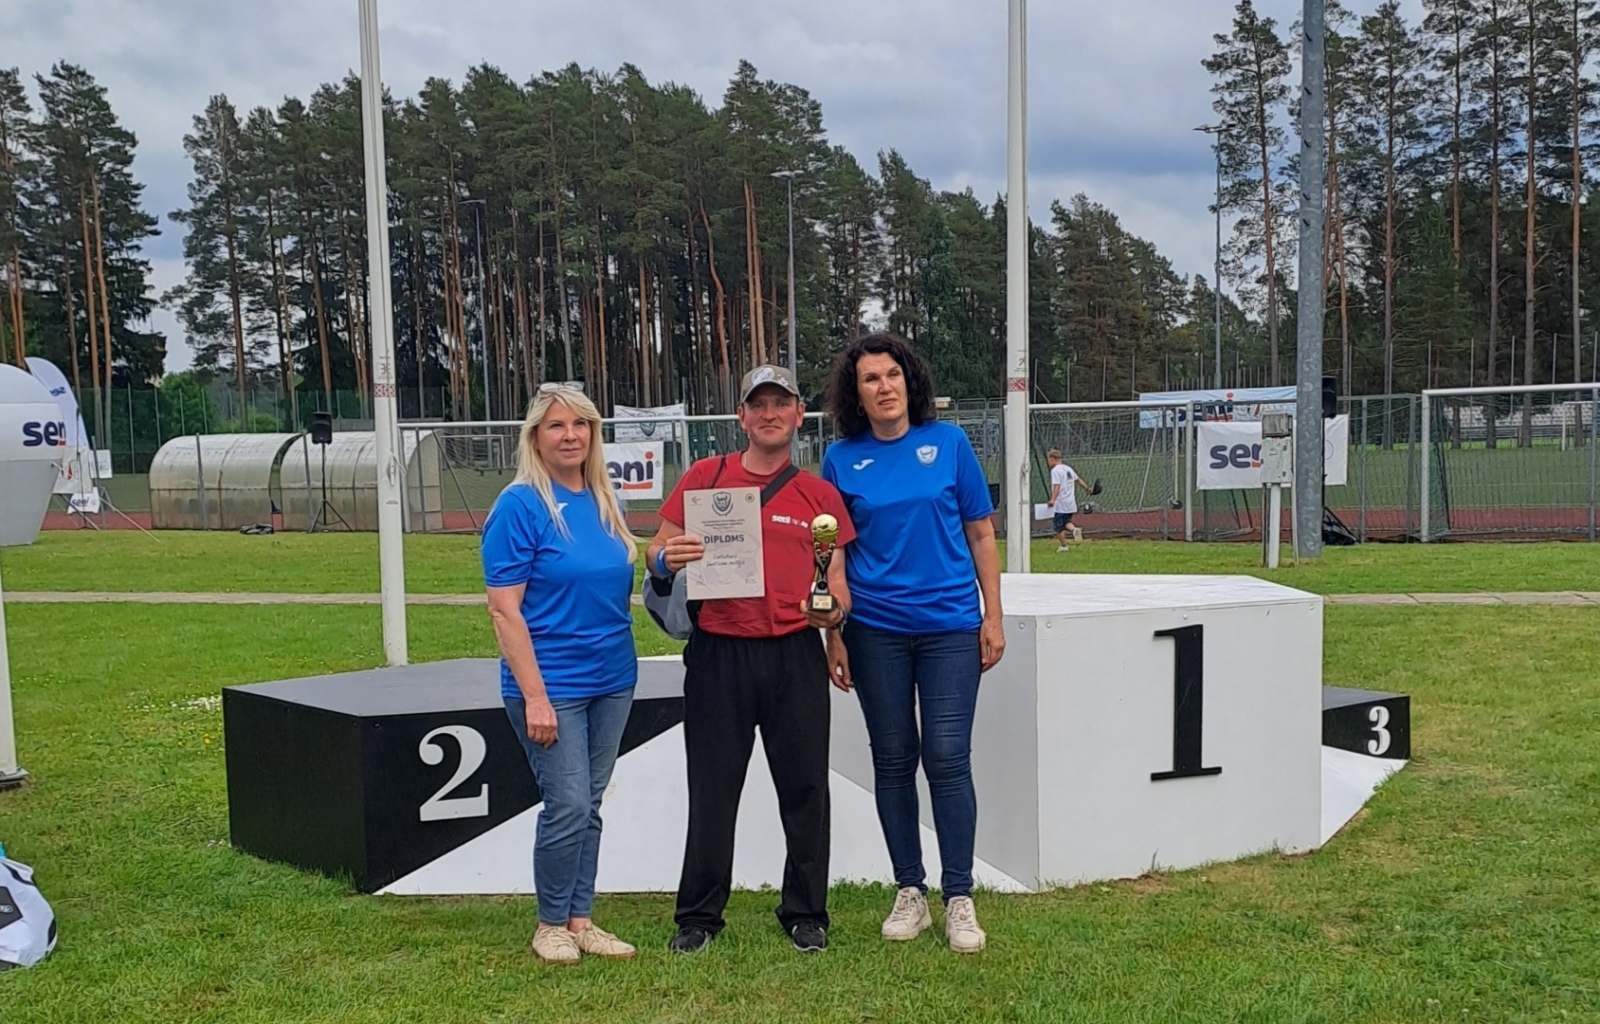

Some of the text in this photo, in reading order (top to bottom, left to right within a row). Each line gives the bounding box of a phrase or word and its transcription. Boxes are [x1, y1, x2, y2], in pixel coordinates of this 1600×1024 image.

[22, 421, 66, 447] sen
[606, 451, 654, 490] eni
[704, 534, 745, 544] DIPLOMS
[1151, 624, 1222, 781] 1
[1367, 705, 1391, 755] 3
[419, 725, 489, 821] 2
